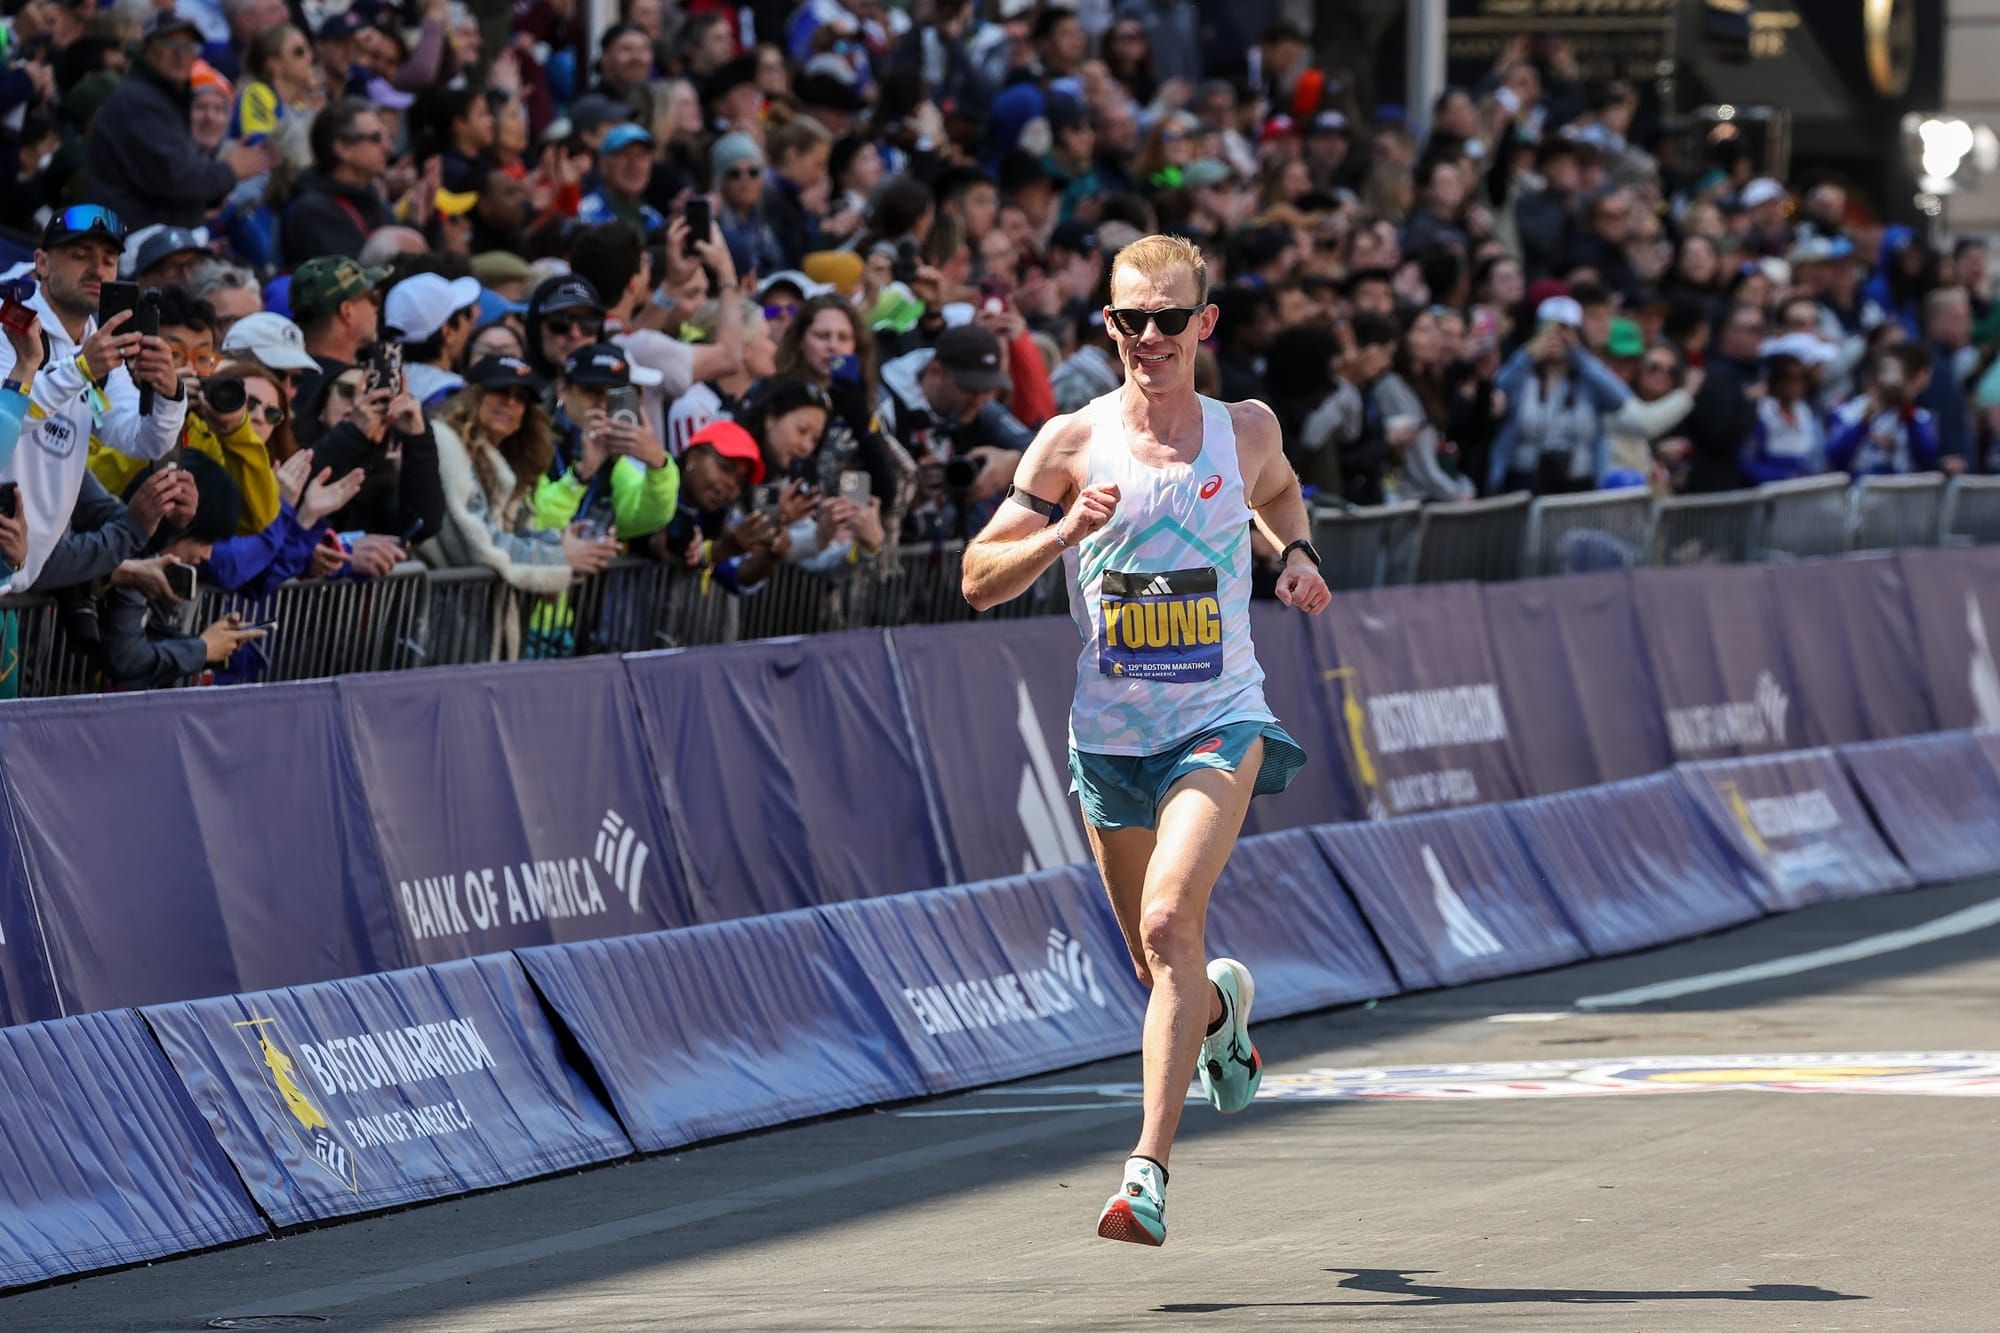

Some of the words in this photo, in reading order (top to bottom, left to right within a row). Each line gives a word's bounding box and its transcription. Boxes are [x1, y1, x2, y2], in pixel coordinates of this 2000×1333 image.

[1101, 597, 1221, 649] YOUNG
[1143, 663, 1170, 671] BOSTON
[1172, 662, 1211, 670] MARATHON
[400, 874, 469, 940] BANK
[465, 868, 500, 930] OF
[503, 857, 607, 924] AMERICA
[300, 1033, 398, 1095] BOSTON
[376, 1017, 496, 1083] MARATHON
[345, 1113, 394, 1148] BANK
[384, 1110, 408, 1143] OF
[408, 1099, 473, 1138] AMERICA
